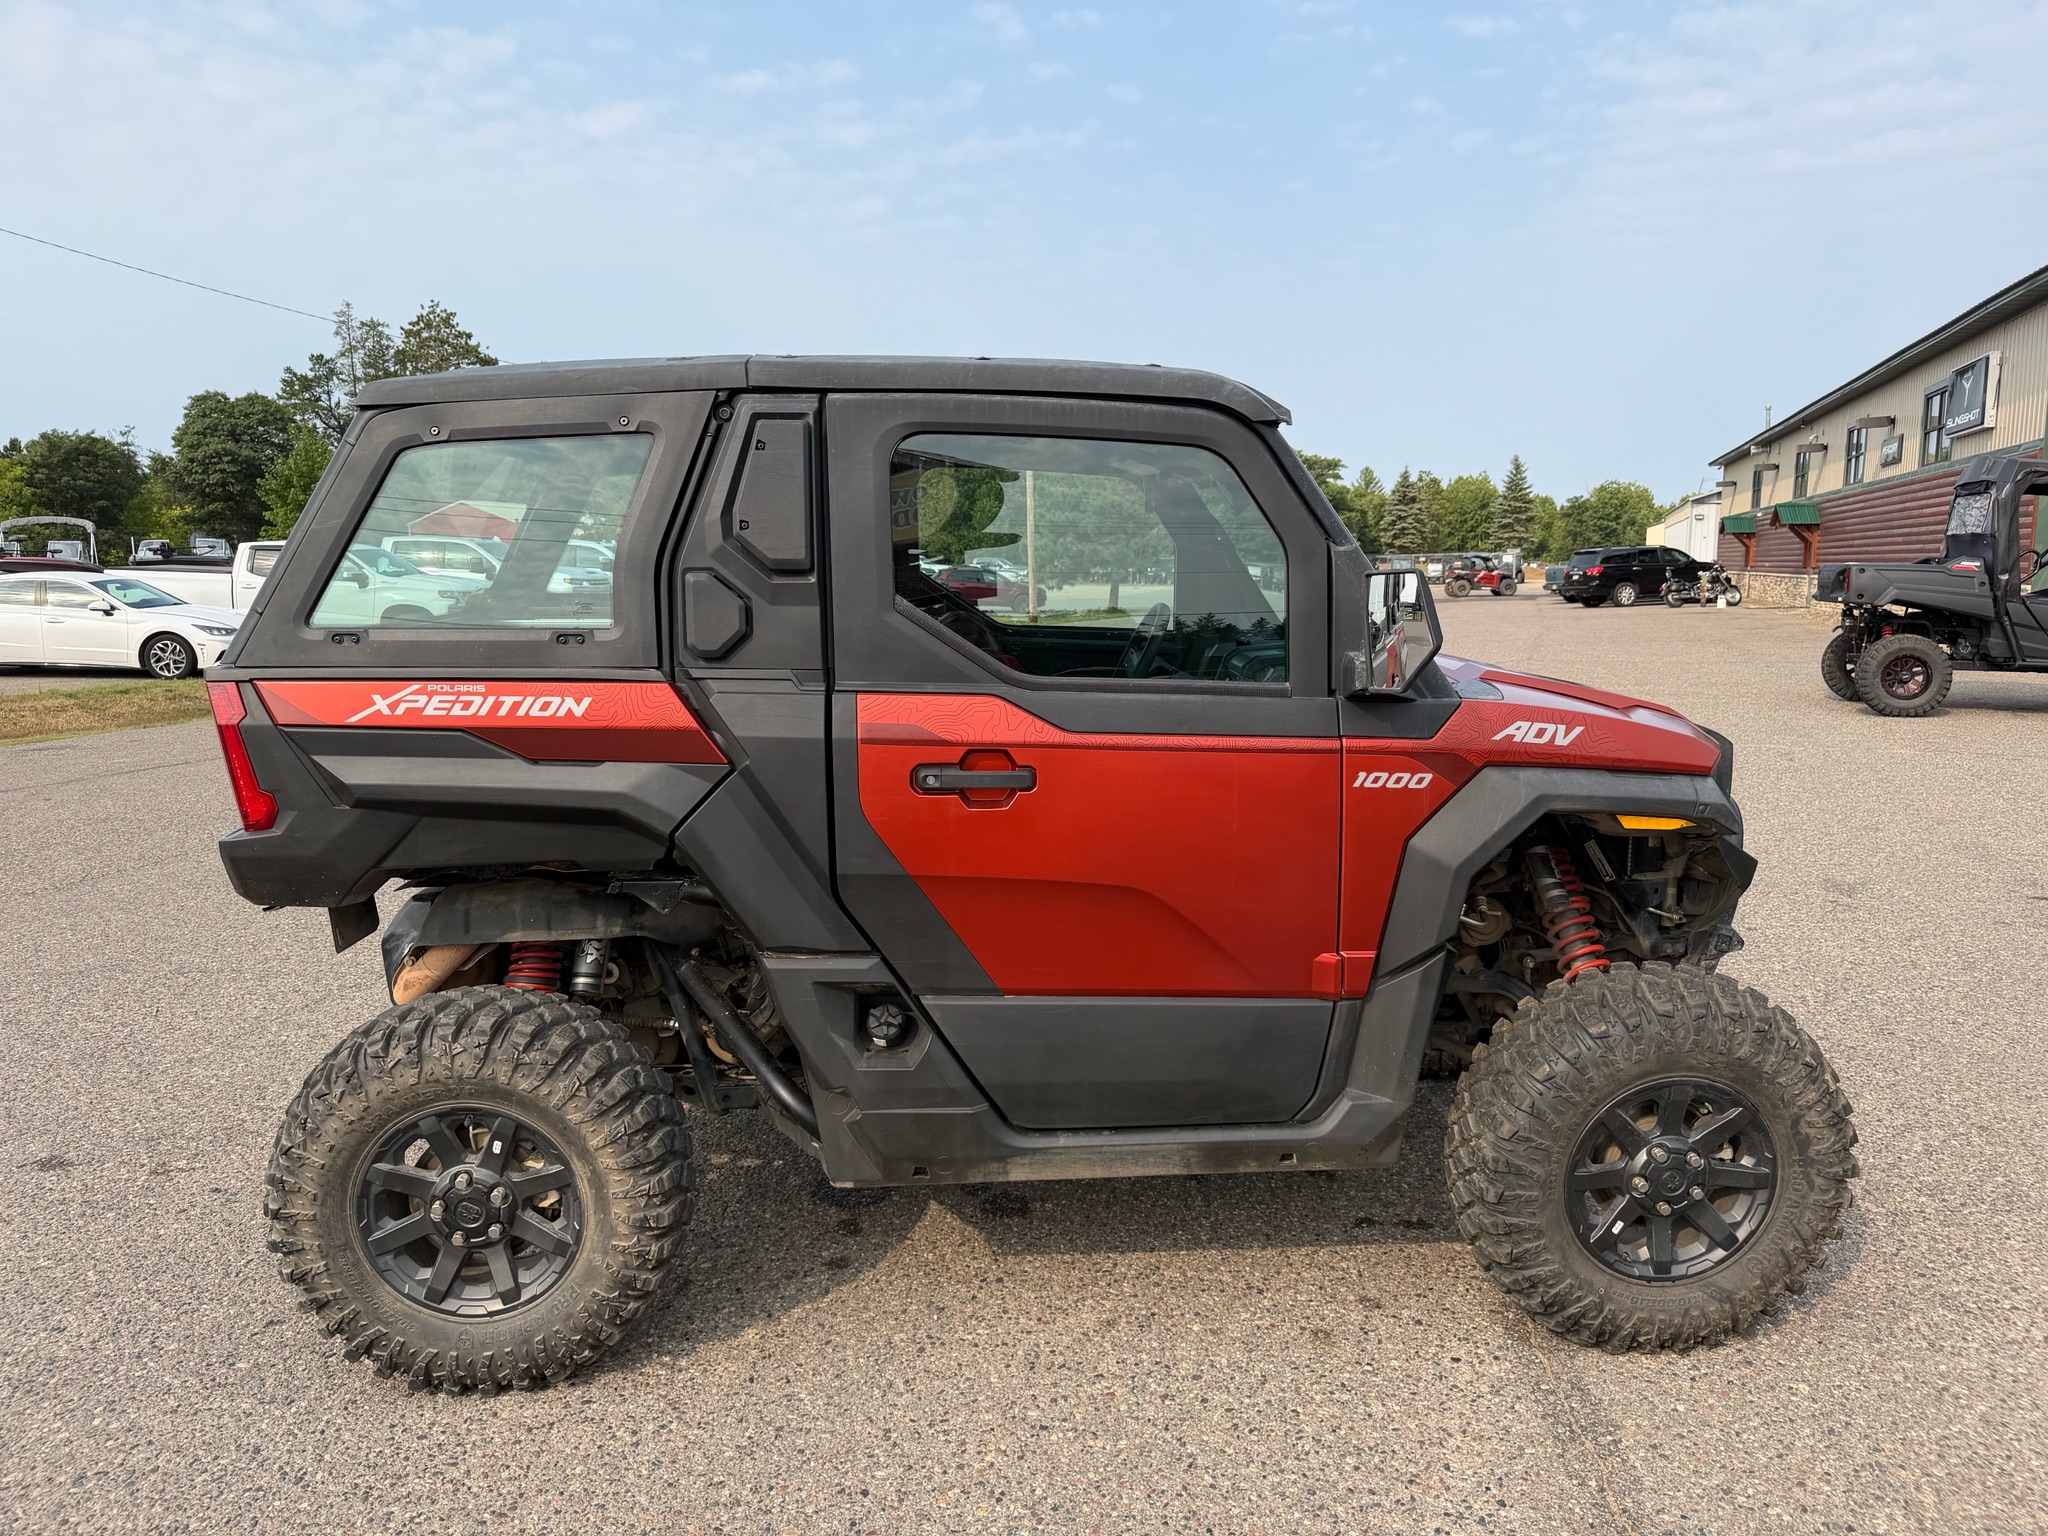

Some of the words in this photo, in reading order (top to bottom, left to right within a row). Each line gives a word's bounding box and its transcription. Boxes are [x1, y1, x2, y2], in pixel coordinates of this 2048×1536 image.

[1946, 408, 1981, 429] SLINGSHOT
[345, 684, 593, 723] XPEDITION
[426, 684, 487, 693] POLARIS
[1491, 720, 1586, 746] ADV
[1352, 771, 1434, 789] 1000
[1788, 1154, 1806, 1194] PRO
[1759, 1193, 1802, 1258] ARMOR
[546, 1283, 582, 1317] PRO
[480, 1309, 548, 1344] ARMOR
